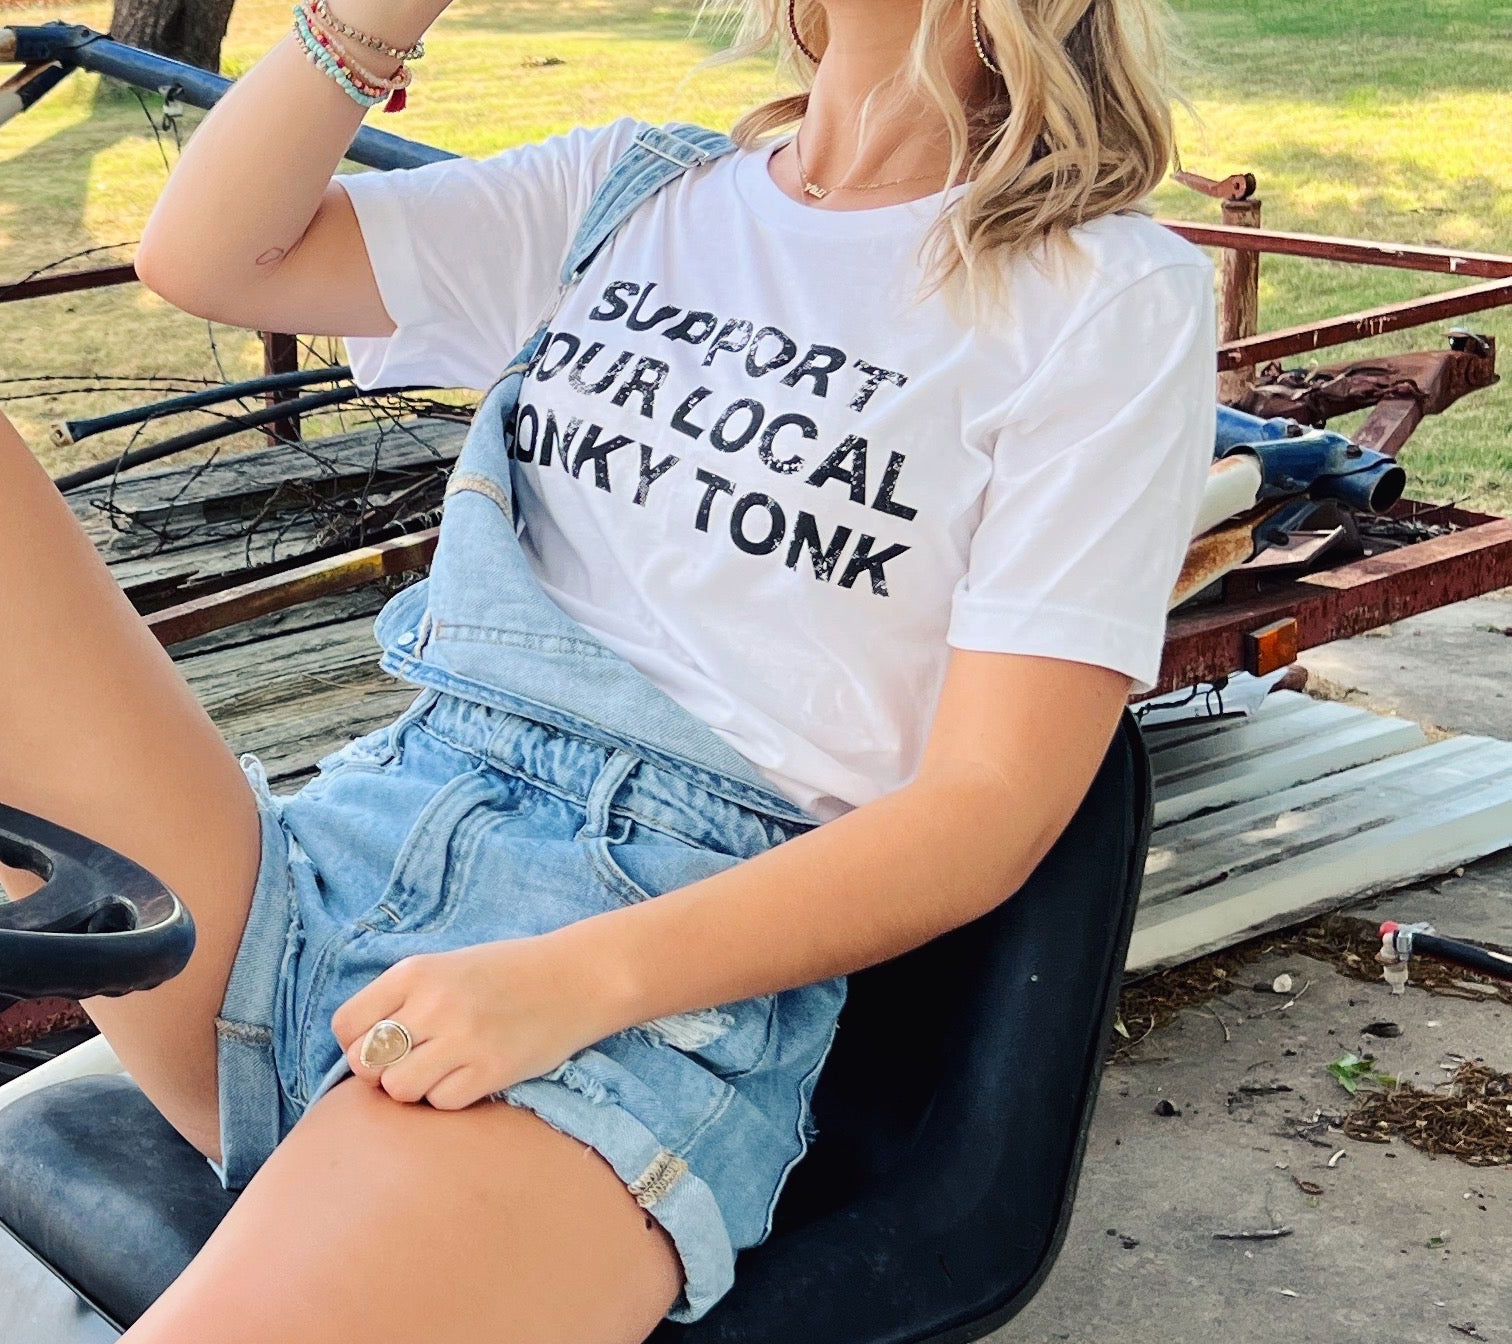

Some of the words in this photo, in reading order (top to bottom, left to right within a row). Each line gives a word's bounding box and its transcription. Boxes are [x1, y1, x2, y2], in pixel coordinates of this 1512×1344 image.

[589, 280, 909, 413] SUPPORT
[670, 385, 919, 522] LOCAL
[695, 467, 912, 598] TONK
